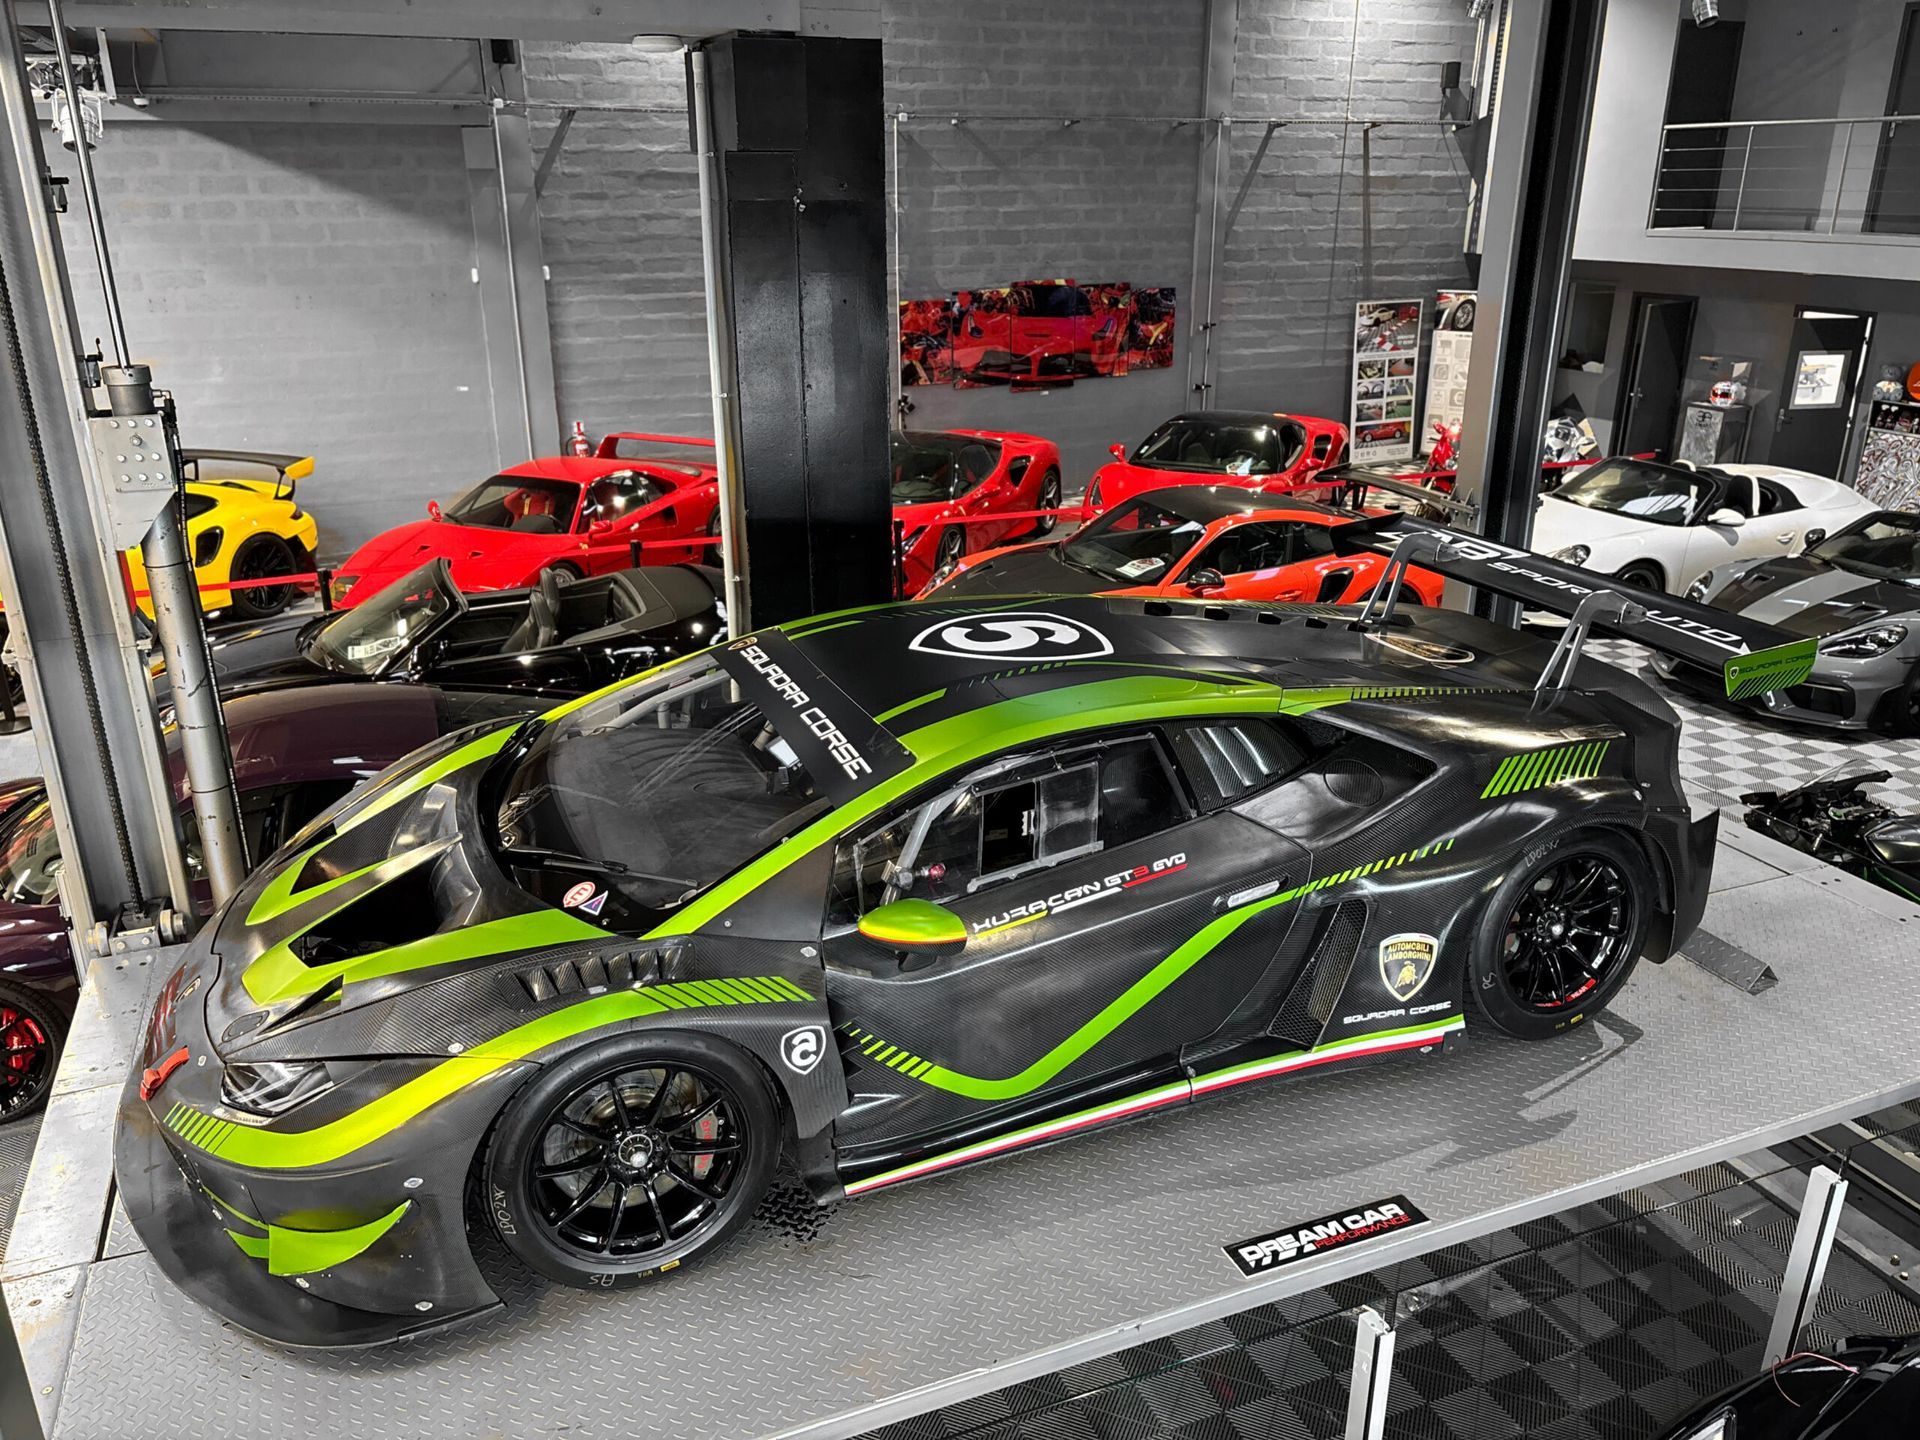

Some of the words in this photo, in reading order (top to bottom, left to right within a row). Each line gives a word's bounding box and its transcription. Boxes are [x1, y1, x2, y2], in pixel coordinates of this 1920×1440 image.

[1487, 561, 1593, 595] SPOR
[1646, 609, 1743, 642] UTO
[1739, 659, 1783, 674] SQUADRA
[740, 645, 811, 708] SQUADRA
[799, 706, 873, 781] CORSE
[1102, 865, 1149, 888] GT3
[1152, 852, 1186, 872] EVO
[1384, 949, 1432, 963] LAMBORGHINI
[1387, 941, 1430, 954] AUTOMOBILI
[1343, 1008, 1406, 1024] SQUADRA
[1409, 1000, 1452, 1015] CORSE
[1238, 1219, 1345, 1264] DREAM
[1343, 1203, 1406, 1230] CAR
[1314, 1213, 1413, 1250] PERFORMANCE
